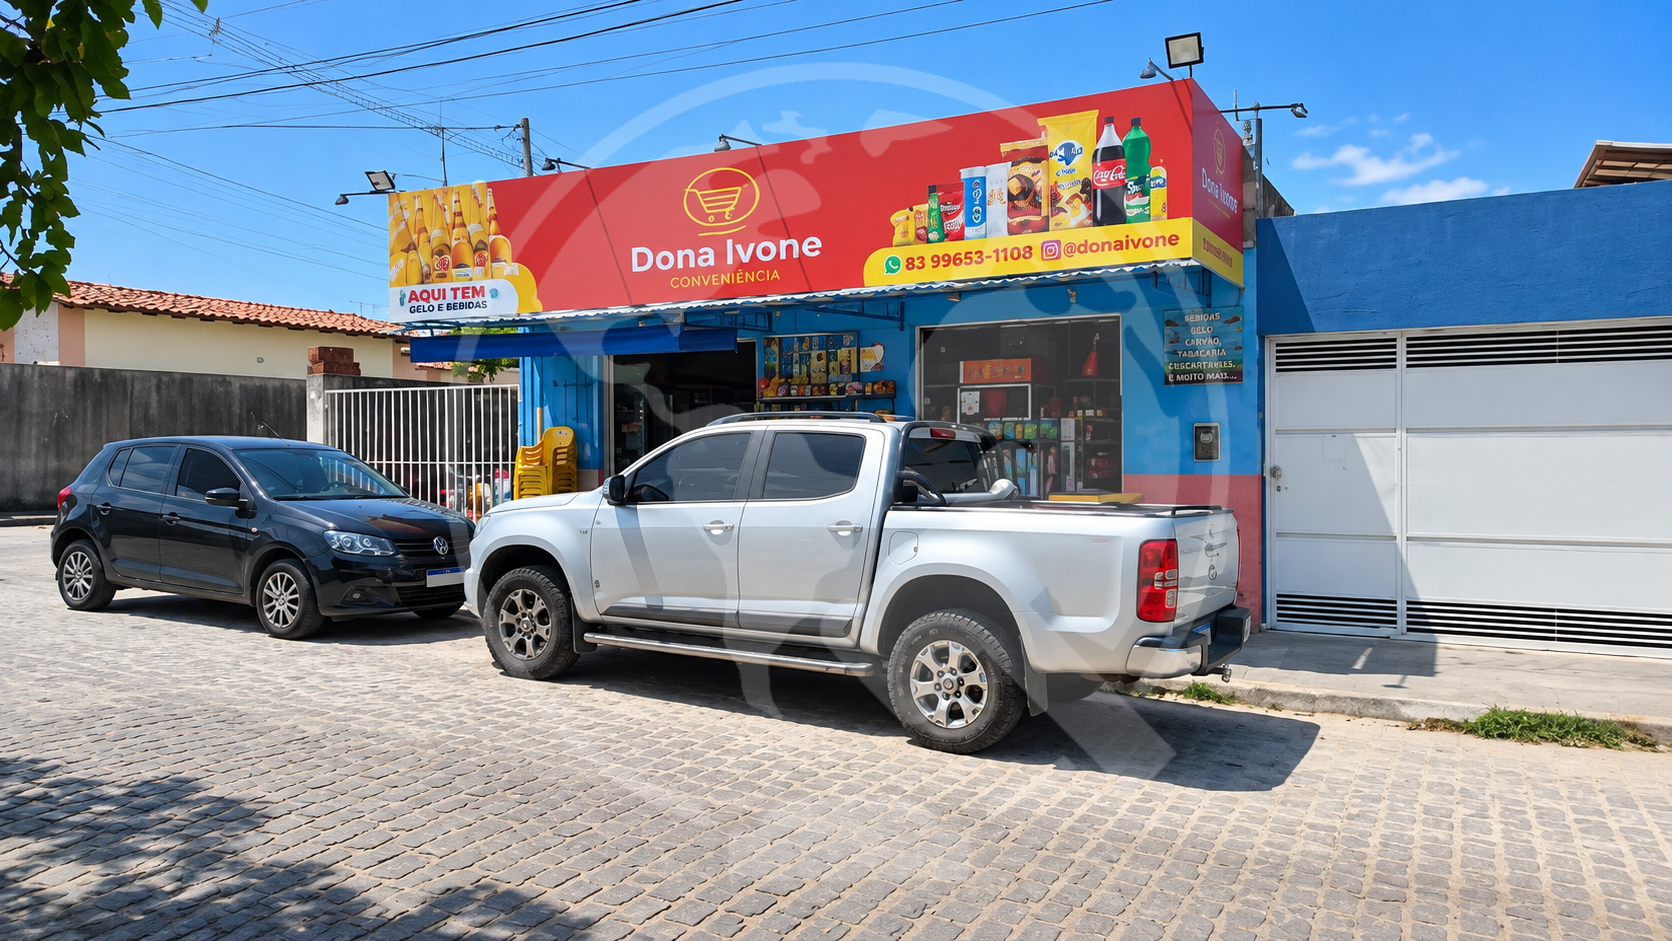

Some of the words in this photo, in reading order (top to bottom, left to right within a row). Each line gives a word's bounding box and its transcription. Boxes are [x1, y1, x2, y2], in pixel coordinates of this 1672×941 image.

[631, 245, 715, 272] Dona
[726, 235, 823, 265] Ivone
[1063, 233, 1180, 257] @donaivone
[905, 255, 926, 271] 83
[930, 245, 1033, 269] 99653-1108
[408, 288, 447, 303] AQUI
[450, 285, 486, 300] TEM
[409, 303, 435, 314] GELO
[437, 303, 444, 312] E
[446, 301, 488, 311] BEBIDAS
